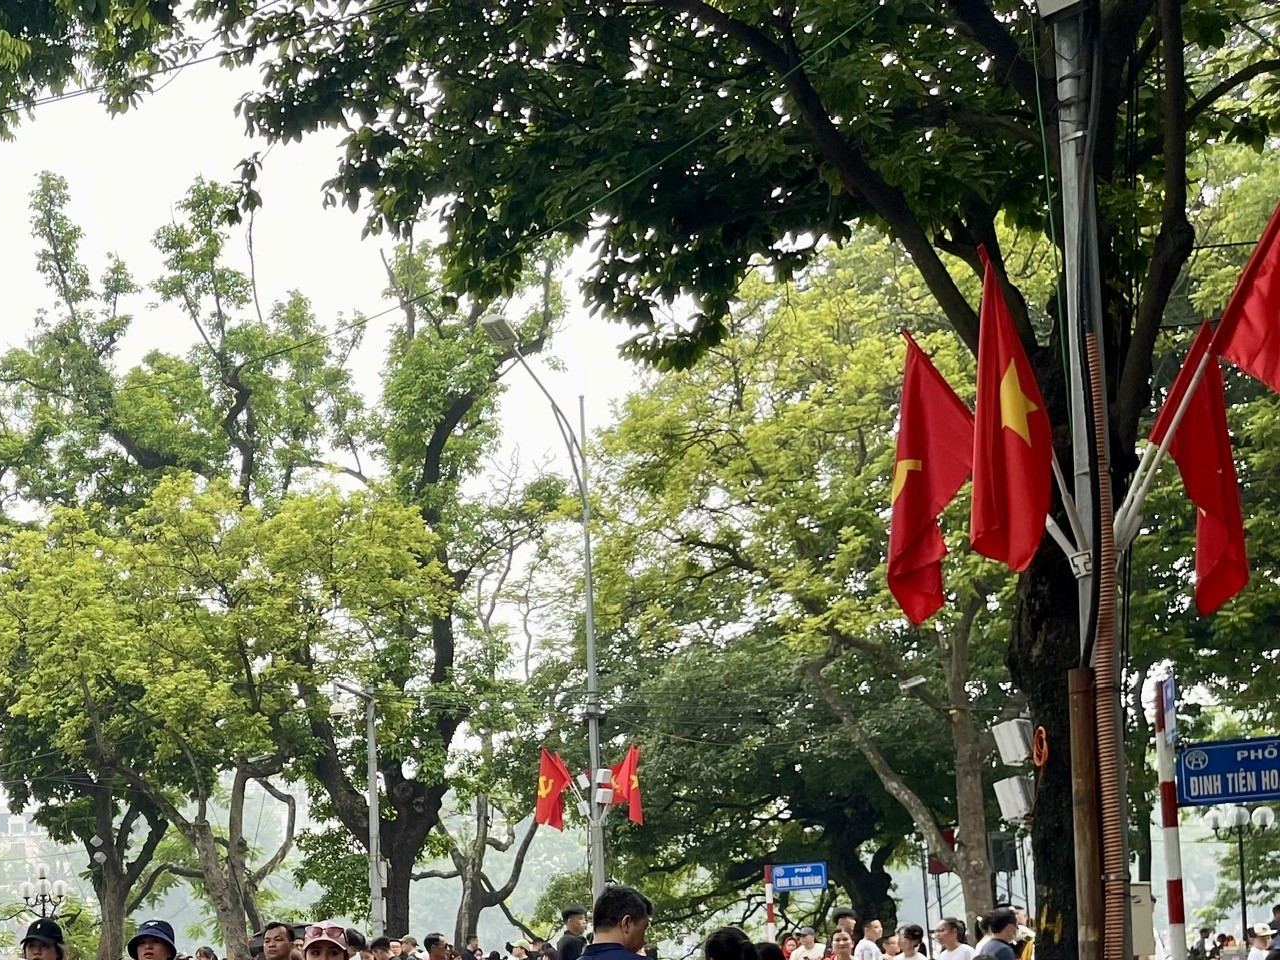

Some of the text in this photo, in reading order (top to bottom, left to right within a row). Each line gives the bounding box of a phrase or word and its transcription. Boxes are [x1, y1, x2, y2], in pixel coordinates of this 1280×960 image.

[1236, 741, 1278, 761] PHỐ
[1189, 767, 1280, 797] ĐINH TIÊN HO
